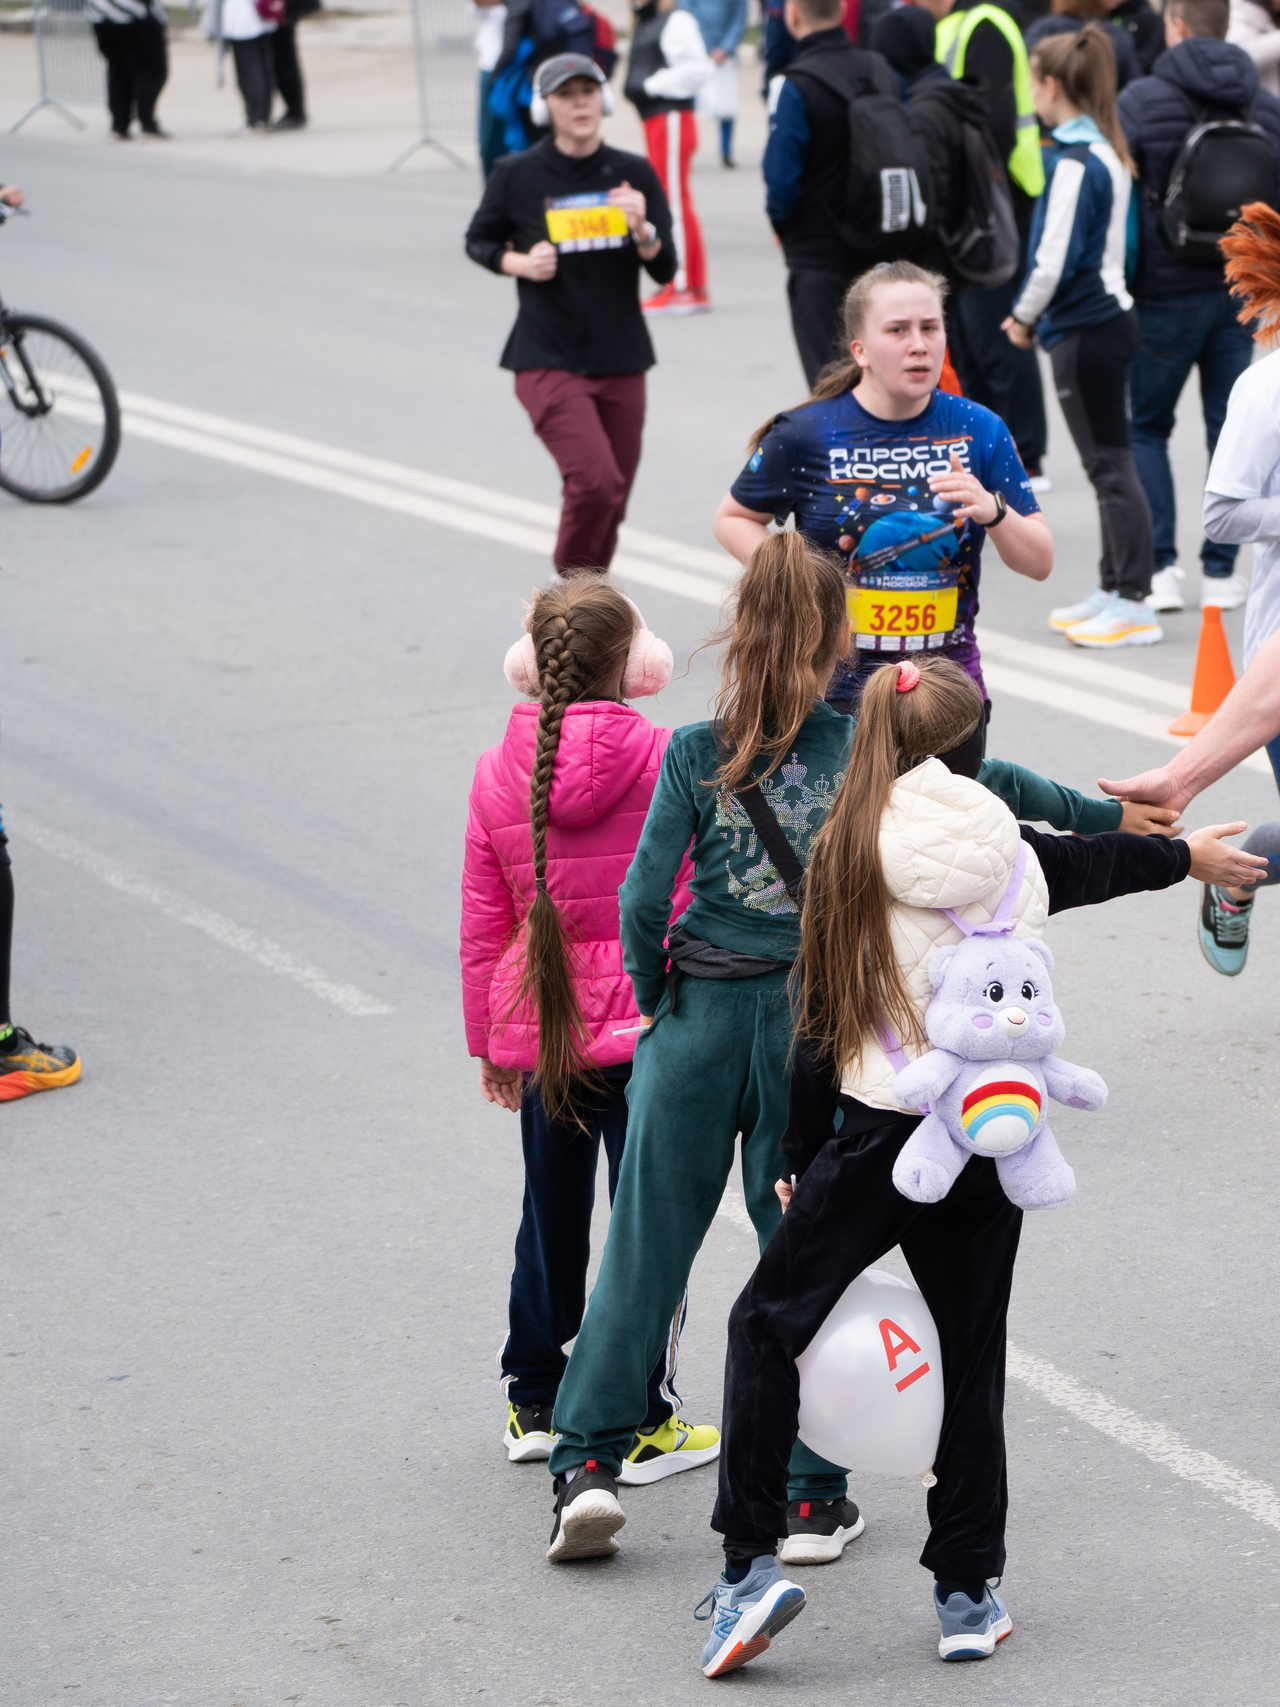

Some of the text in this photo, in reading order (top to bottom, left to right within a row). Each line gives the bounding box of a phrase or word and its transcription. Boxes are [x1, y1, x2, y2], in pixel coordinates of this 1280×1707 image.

[829, 440, 969, 462] Я ПРОСТО
[869, 604, 936, 631] 3256
